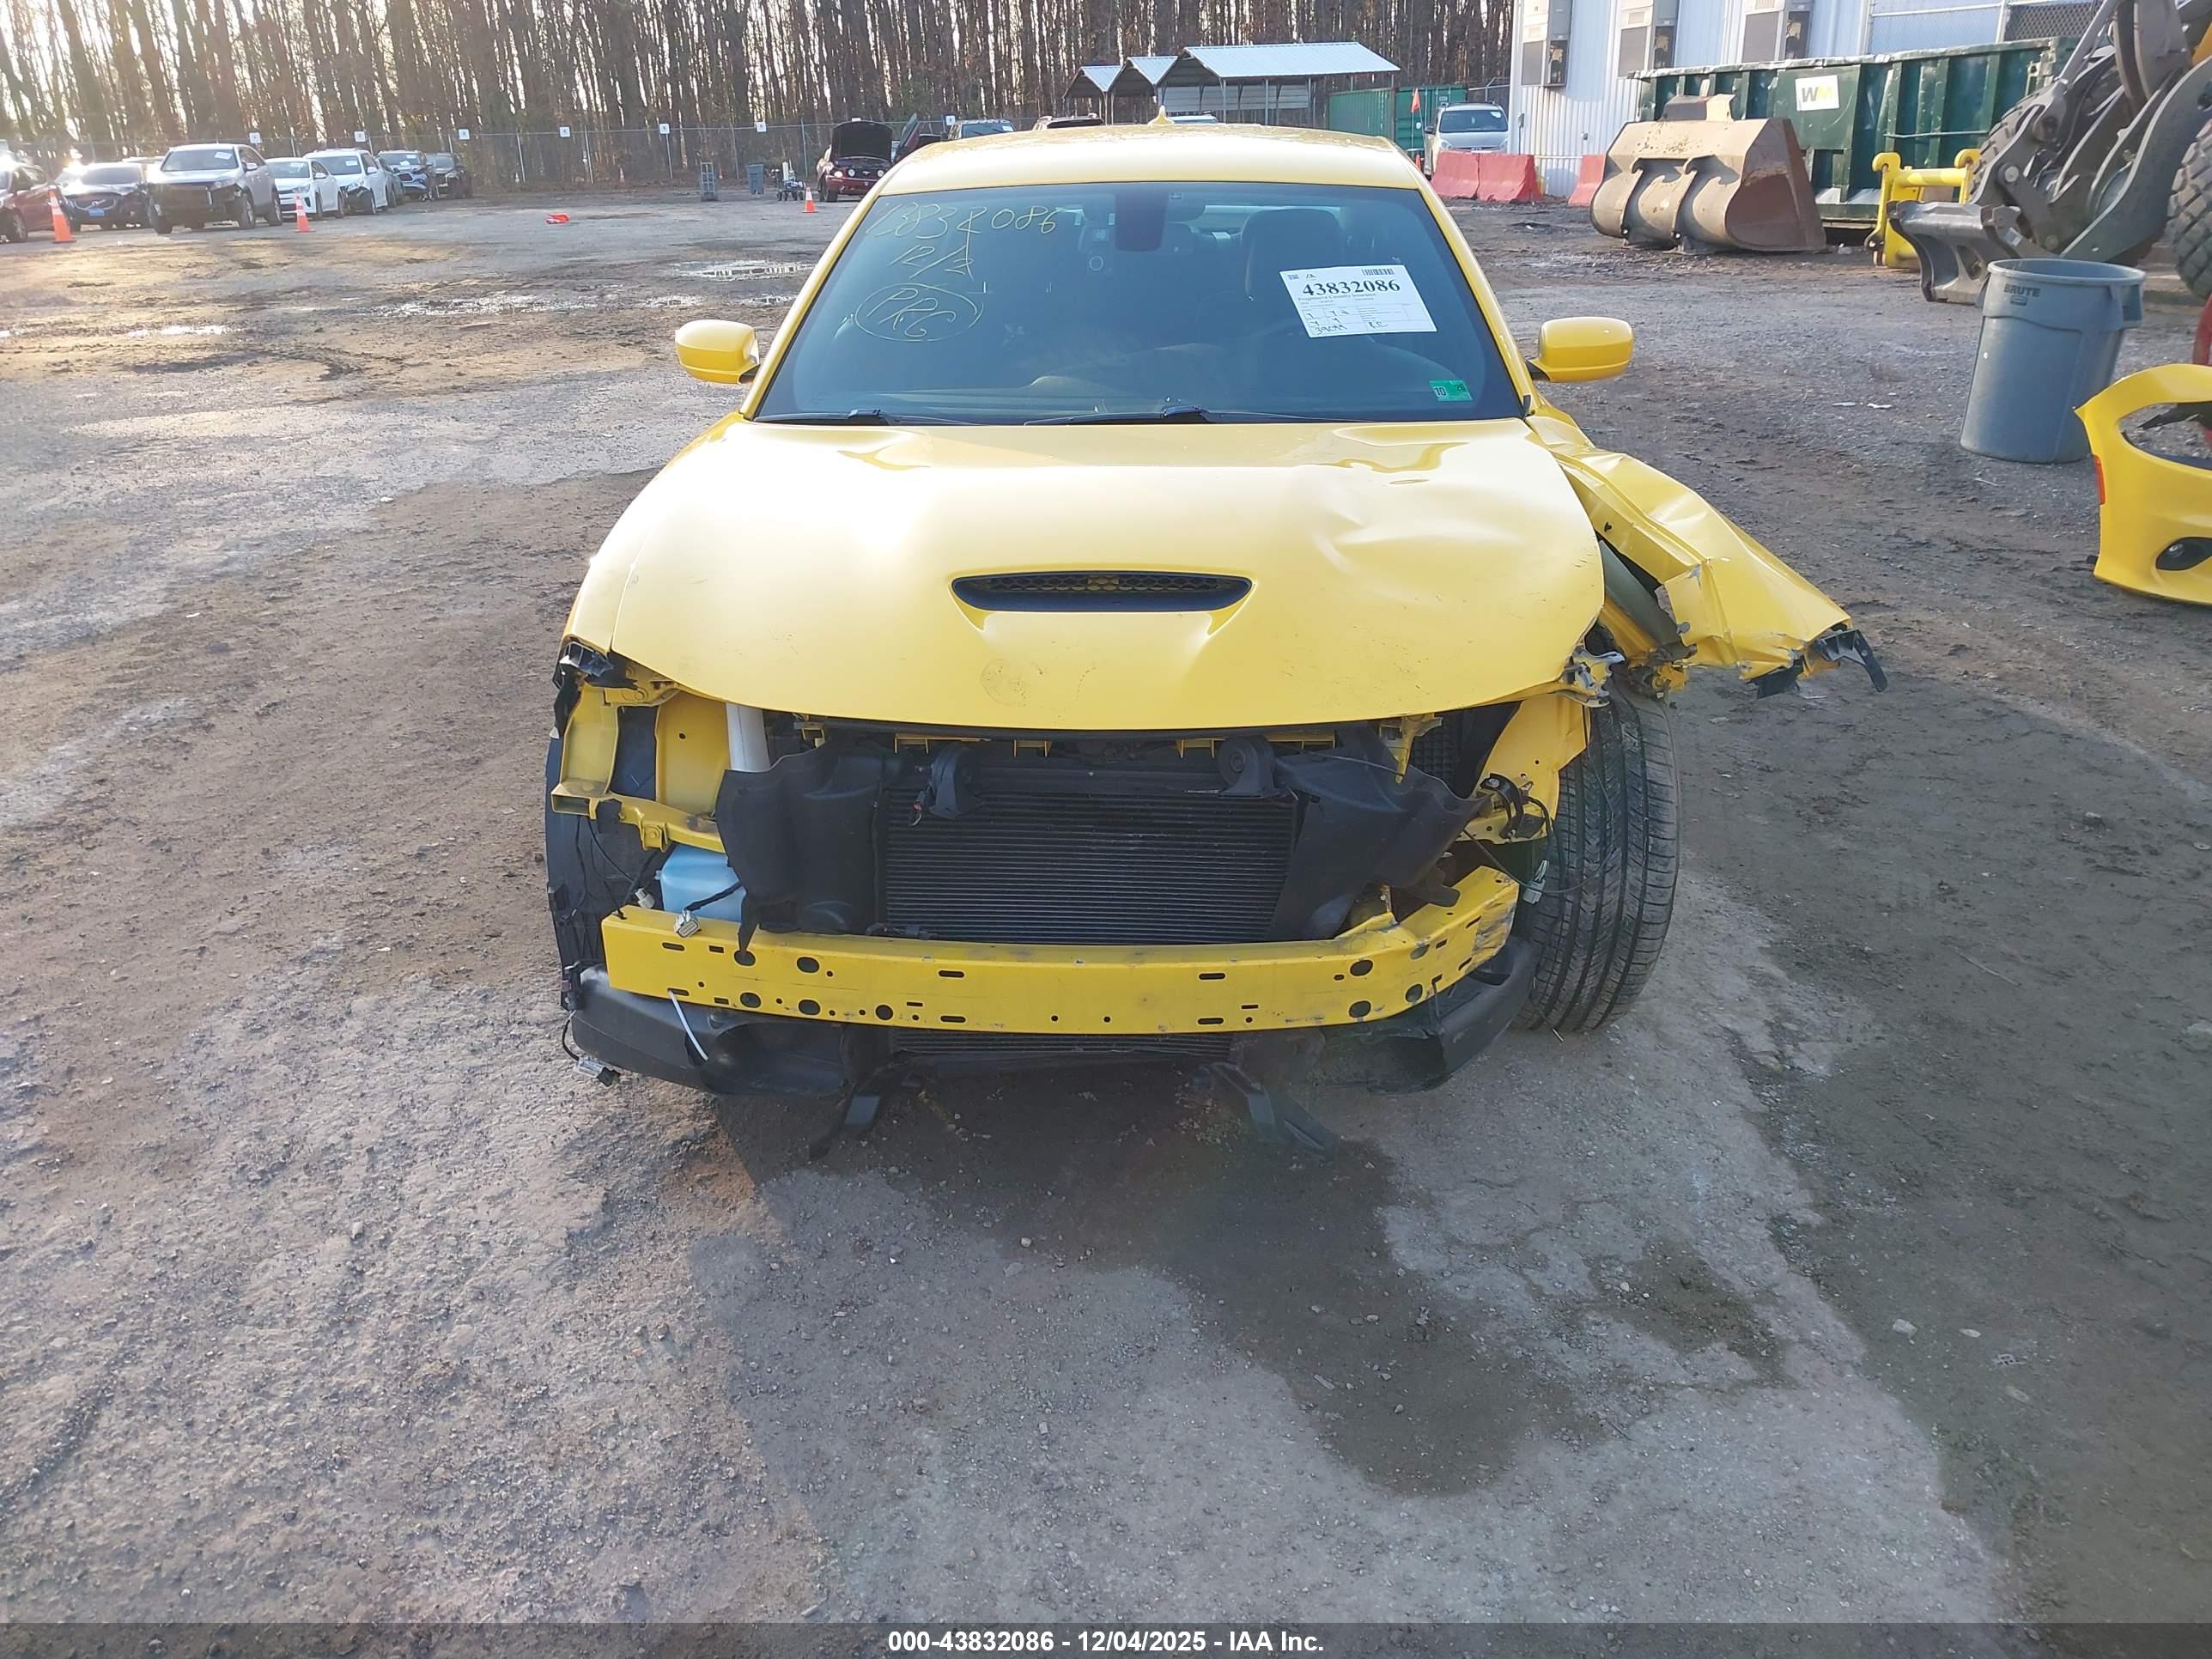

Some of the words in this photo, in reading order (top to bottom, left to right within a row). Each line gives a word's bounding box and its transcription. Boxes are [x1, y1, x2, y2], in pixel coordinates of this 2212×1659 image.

[1802, 86, 1832, 102] WM
[1303, 279, 1401, 296] 43832086
[2003, 283, 2041, 297] BRUTE
[1435, 386, 1447, 396] 10
